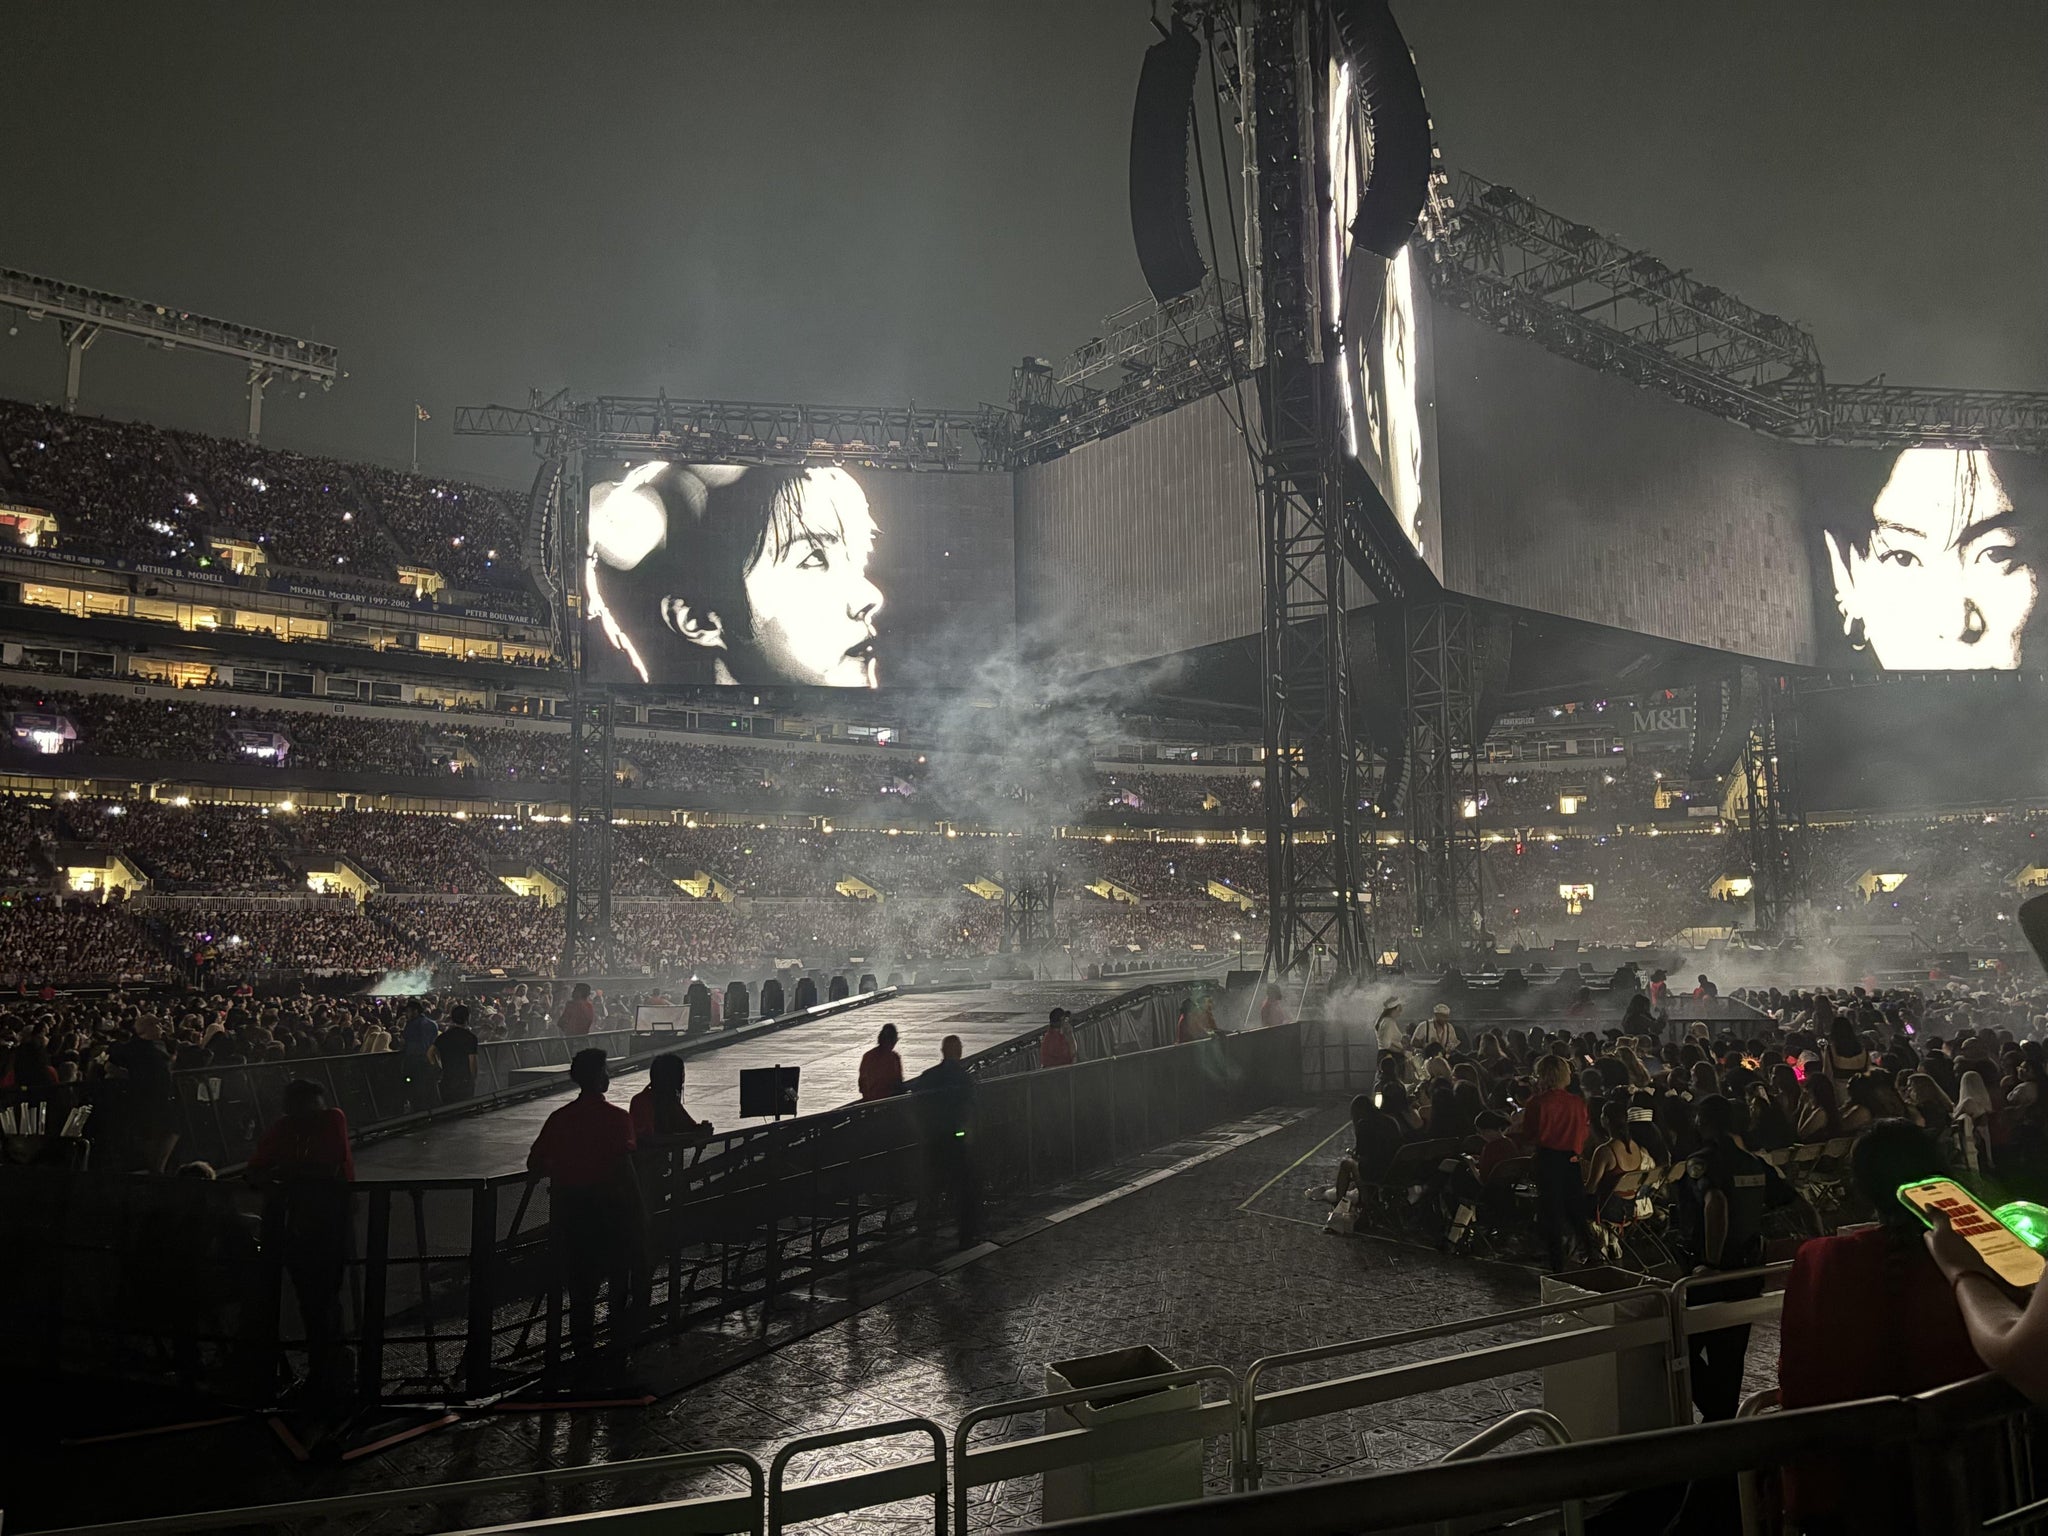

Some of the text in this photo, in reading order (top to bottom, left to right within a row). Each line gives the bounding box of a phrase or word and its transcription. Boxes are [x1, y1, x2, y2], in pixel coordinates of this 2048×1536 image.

[135, 564, 225, 583] ARTHUR B. MODELL
[289, 585, 411, 609] MICHAEL McCRARY 1997-2002
[465, 609, 488, 619] PETER
[489, 612, 529, 624] BOULWARE
[1631, 706, 1693, 733] M&T
